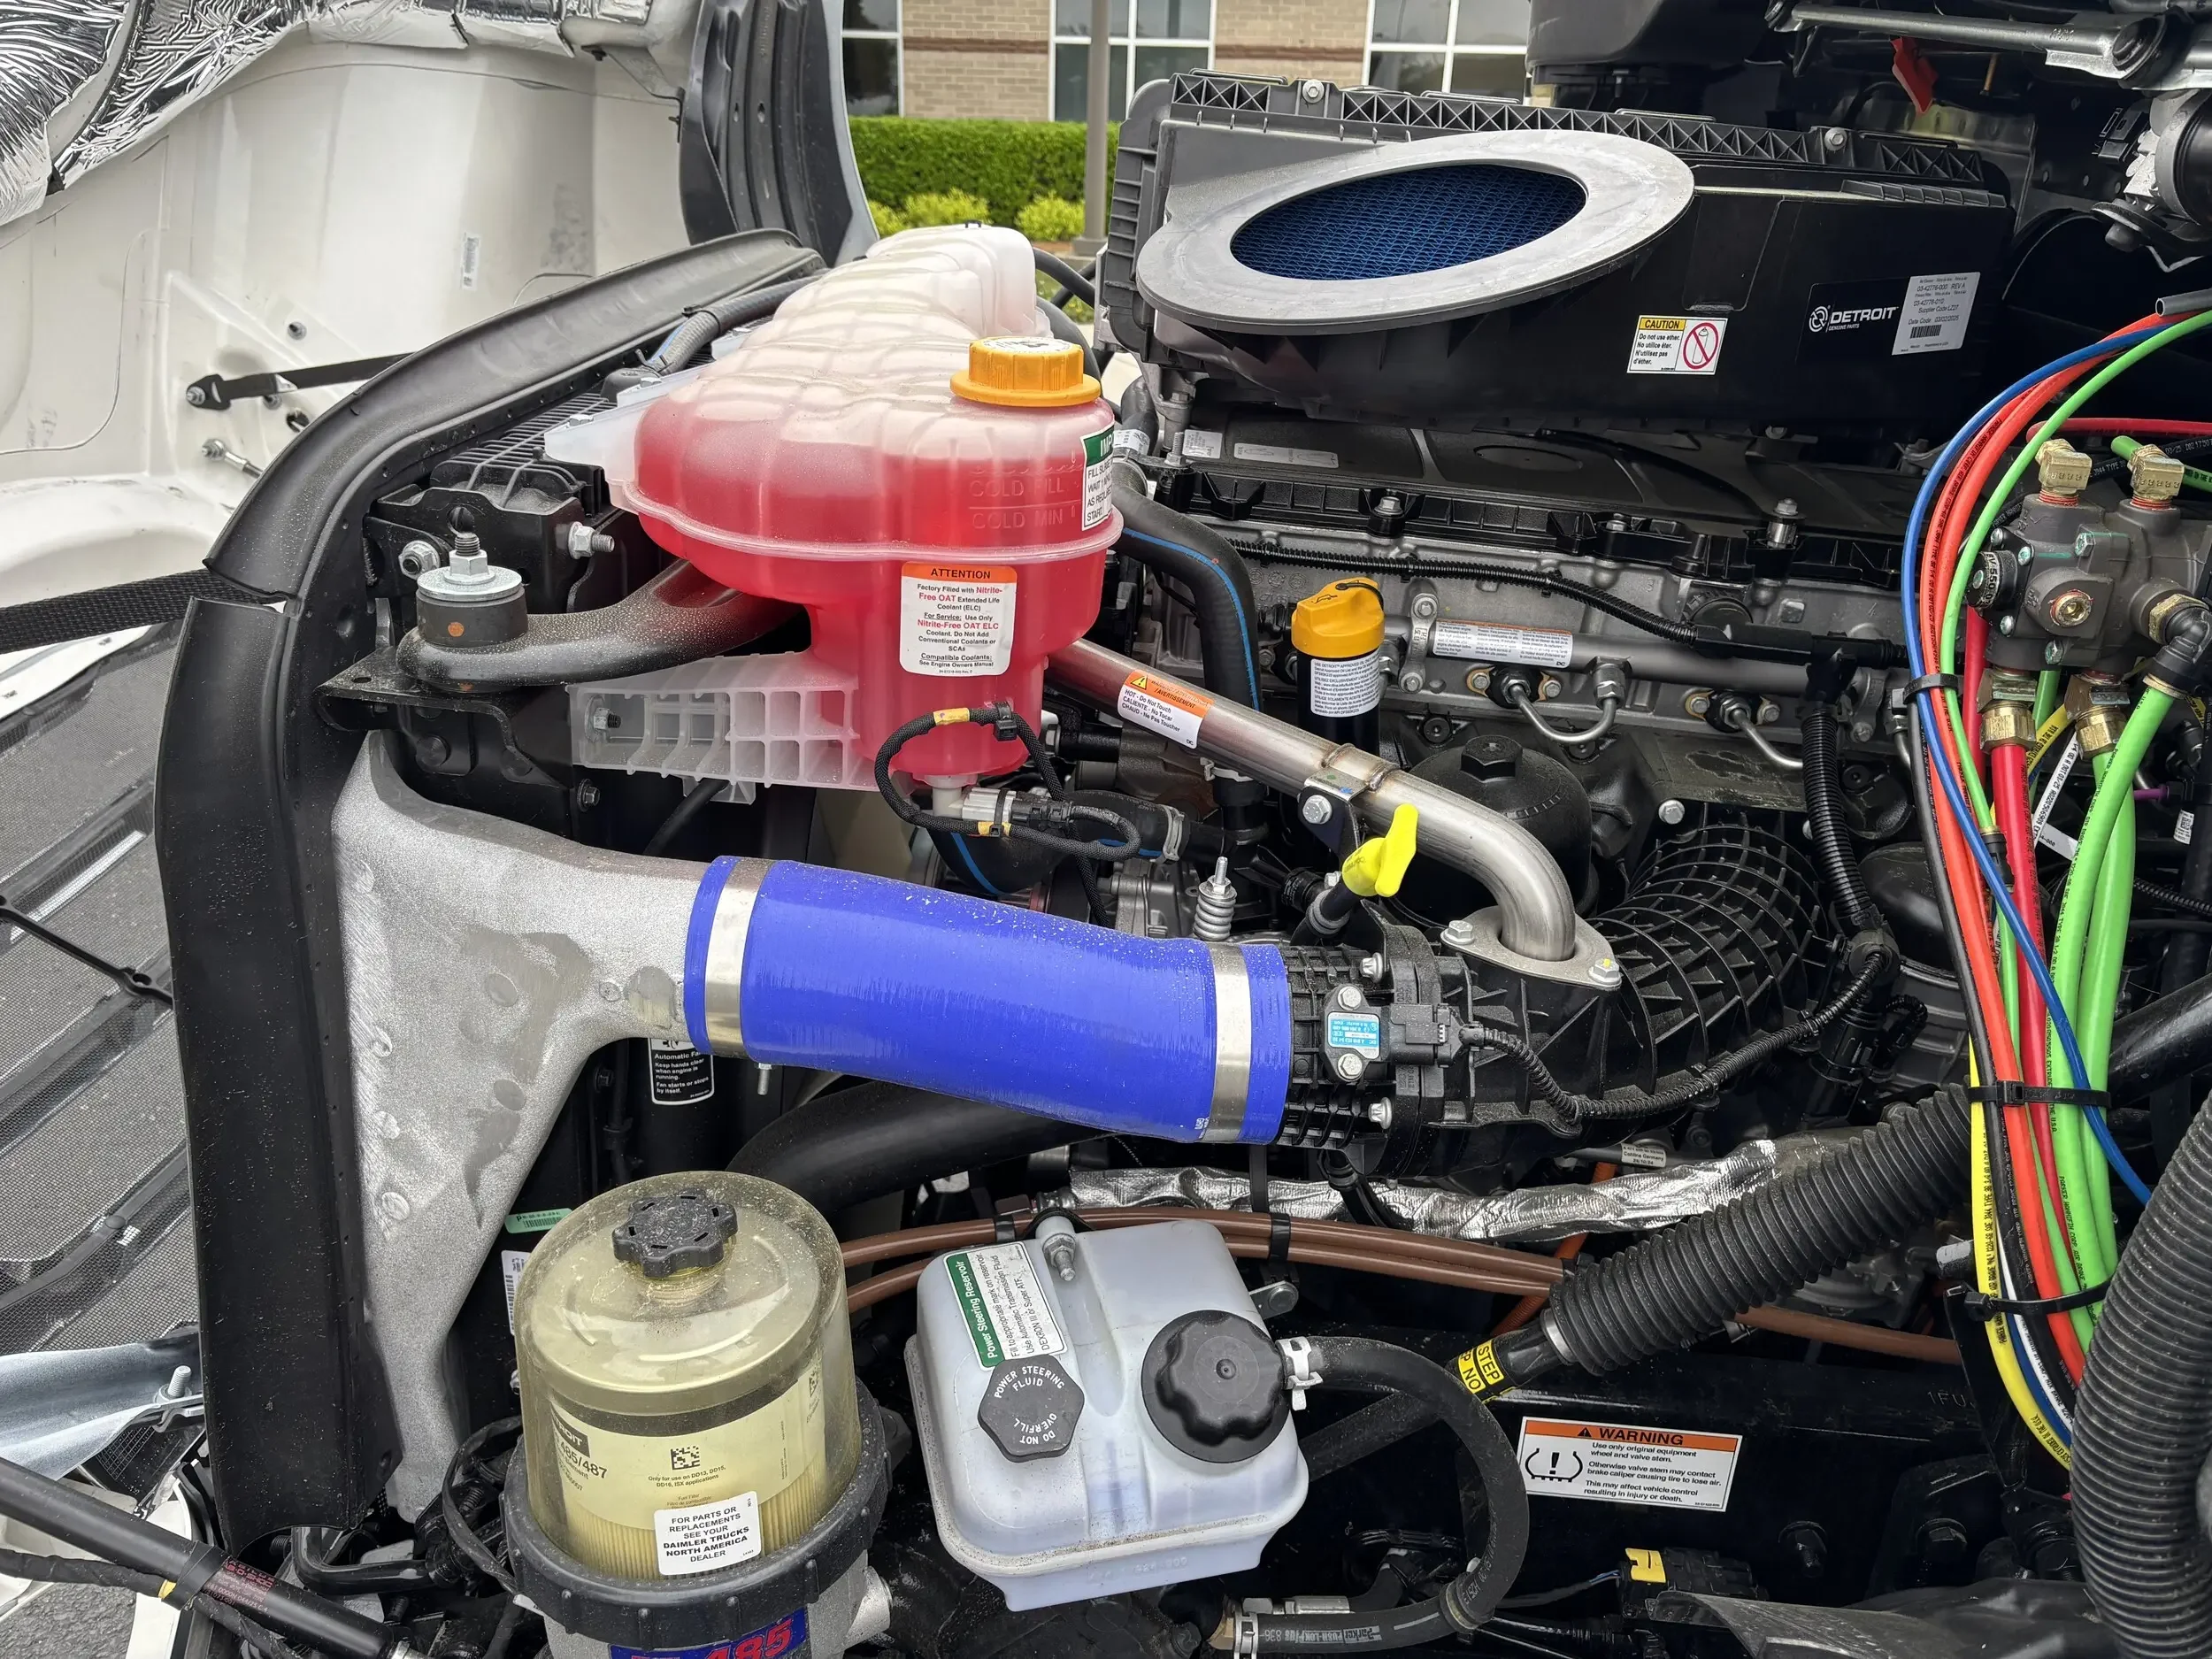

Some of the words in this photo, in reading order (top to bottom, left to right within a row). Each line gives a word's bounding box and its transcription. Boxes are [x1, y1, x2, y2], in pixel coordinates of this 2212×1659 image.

[1831, 307, 1897, 324] DETROIT
[1645, 320, 1679, 329] CAUTION
[970, 480, 1024, 496] COLD
[1034, 478, 1064, 494] FILL
[973, 511, 1025, 529] COLD
[1035, 509, 1063, 526] MIN
[931, 568, 991, 579] ATTENTION
[918, 584, 941, 593] Factory
[918, 619, 961, 629] Nitrite-Free
[1123, 696, 1148, 710] CALIENTE
[1159, 710, 1173, 721] Tocar
[1125, 689, 1136, 698] HOT
[1157, 703, 1171, 713] Touch
[1122, 703, 1140, 715] CHAUD
[1161, 719, 1180, 732] Toucher
[992, 1255, 1002, 1271] Fluid
[956, 1262, 975, 1297] Reservoir
[998, 1271, 1017, 1310] Transmission
[1021, 1292, 1033, 1308] Super
[970, 1298, 988, 1332] Steering
[1013, 1310, 1028, 1339] Automatic
[1032, 1322, 1050, 1350] DEXRON
[982, 1333, 998, 1359] Power
[1025, 1340, 1035, 1354] Use
[1478, 1346, 1501, 1380] STEP
[994, 1369, 1018, 1399] POWER
[1021, 1365, 1065, 1390] STEERING
[1012, 1377, 1044, 1392] FLUID
[1463, 1367, 1481, 1390] NO
[1013, 1412, 1058, 1433] OVERFILL
[1019, 1434, 1040, 1445] NOT
[1042, 1429, 1056, 1443] DO
[1599, 1427, 1684, 1447] WARNING
[561, 1441, 608, 1479] 485/487
[1591, 1449, 1613, 1458] wheel
[1609, 1445, 1625, 1454] only
[1626, 1446, 1655, 1455] original
[1656, 1448, 1697, 1458] equipment
[710, 1465, 726, 1474] DD15,
[1587, 1468, 1609, 1477] brake
[1609, 1471, 1636, 1479] caliper
[1637, 1473, 1667, 1482] causing
[1588, 1462, 1626, 1471] Otherwise
[686, 1474, 719, 1486] applications
[1586, 1479, 1601, 1488] This
[1620, 1482, 1642, 1492] affect
[1643, 1485, 1670, 1494] vehicle
[1671, 1487, 1699, 1496] control
[1584, 1487, 1617, 1498] resulting
[1626, 1492, 1648, 1501] injury
[1659, 1494, 1683, 1503] death.
[669, 1513, 741, 1532] REPLACEMENTS
[693, 1510, 722, 1522] PARTS
[724, 1506, 737, 1515] OR
[663, 1539, 708, 1549] DAIMLER
[710, 1526, 749, 1542] TRUCKS
[684, 1531, 701, 1540] SEE
[703, 1525, 728, 1536] YOUR
[666, 1548, 701, 1556] NORTH
[703, 1535, 748, 1552] AMERICA
[690, 1549, 726, 1563] DEALER
[1344, 1628, 1373, 1641] Parker
